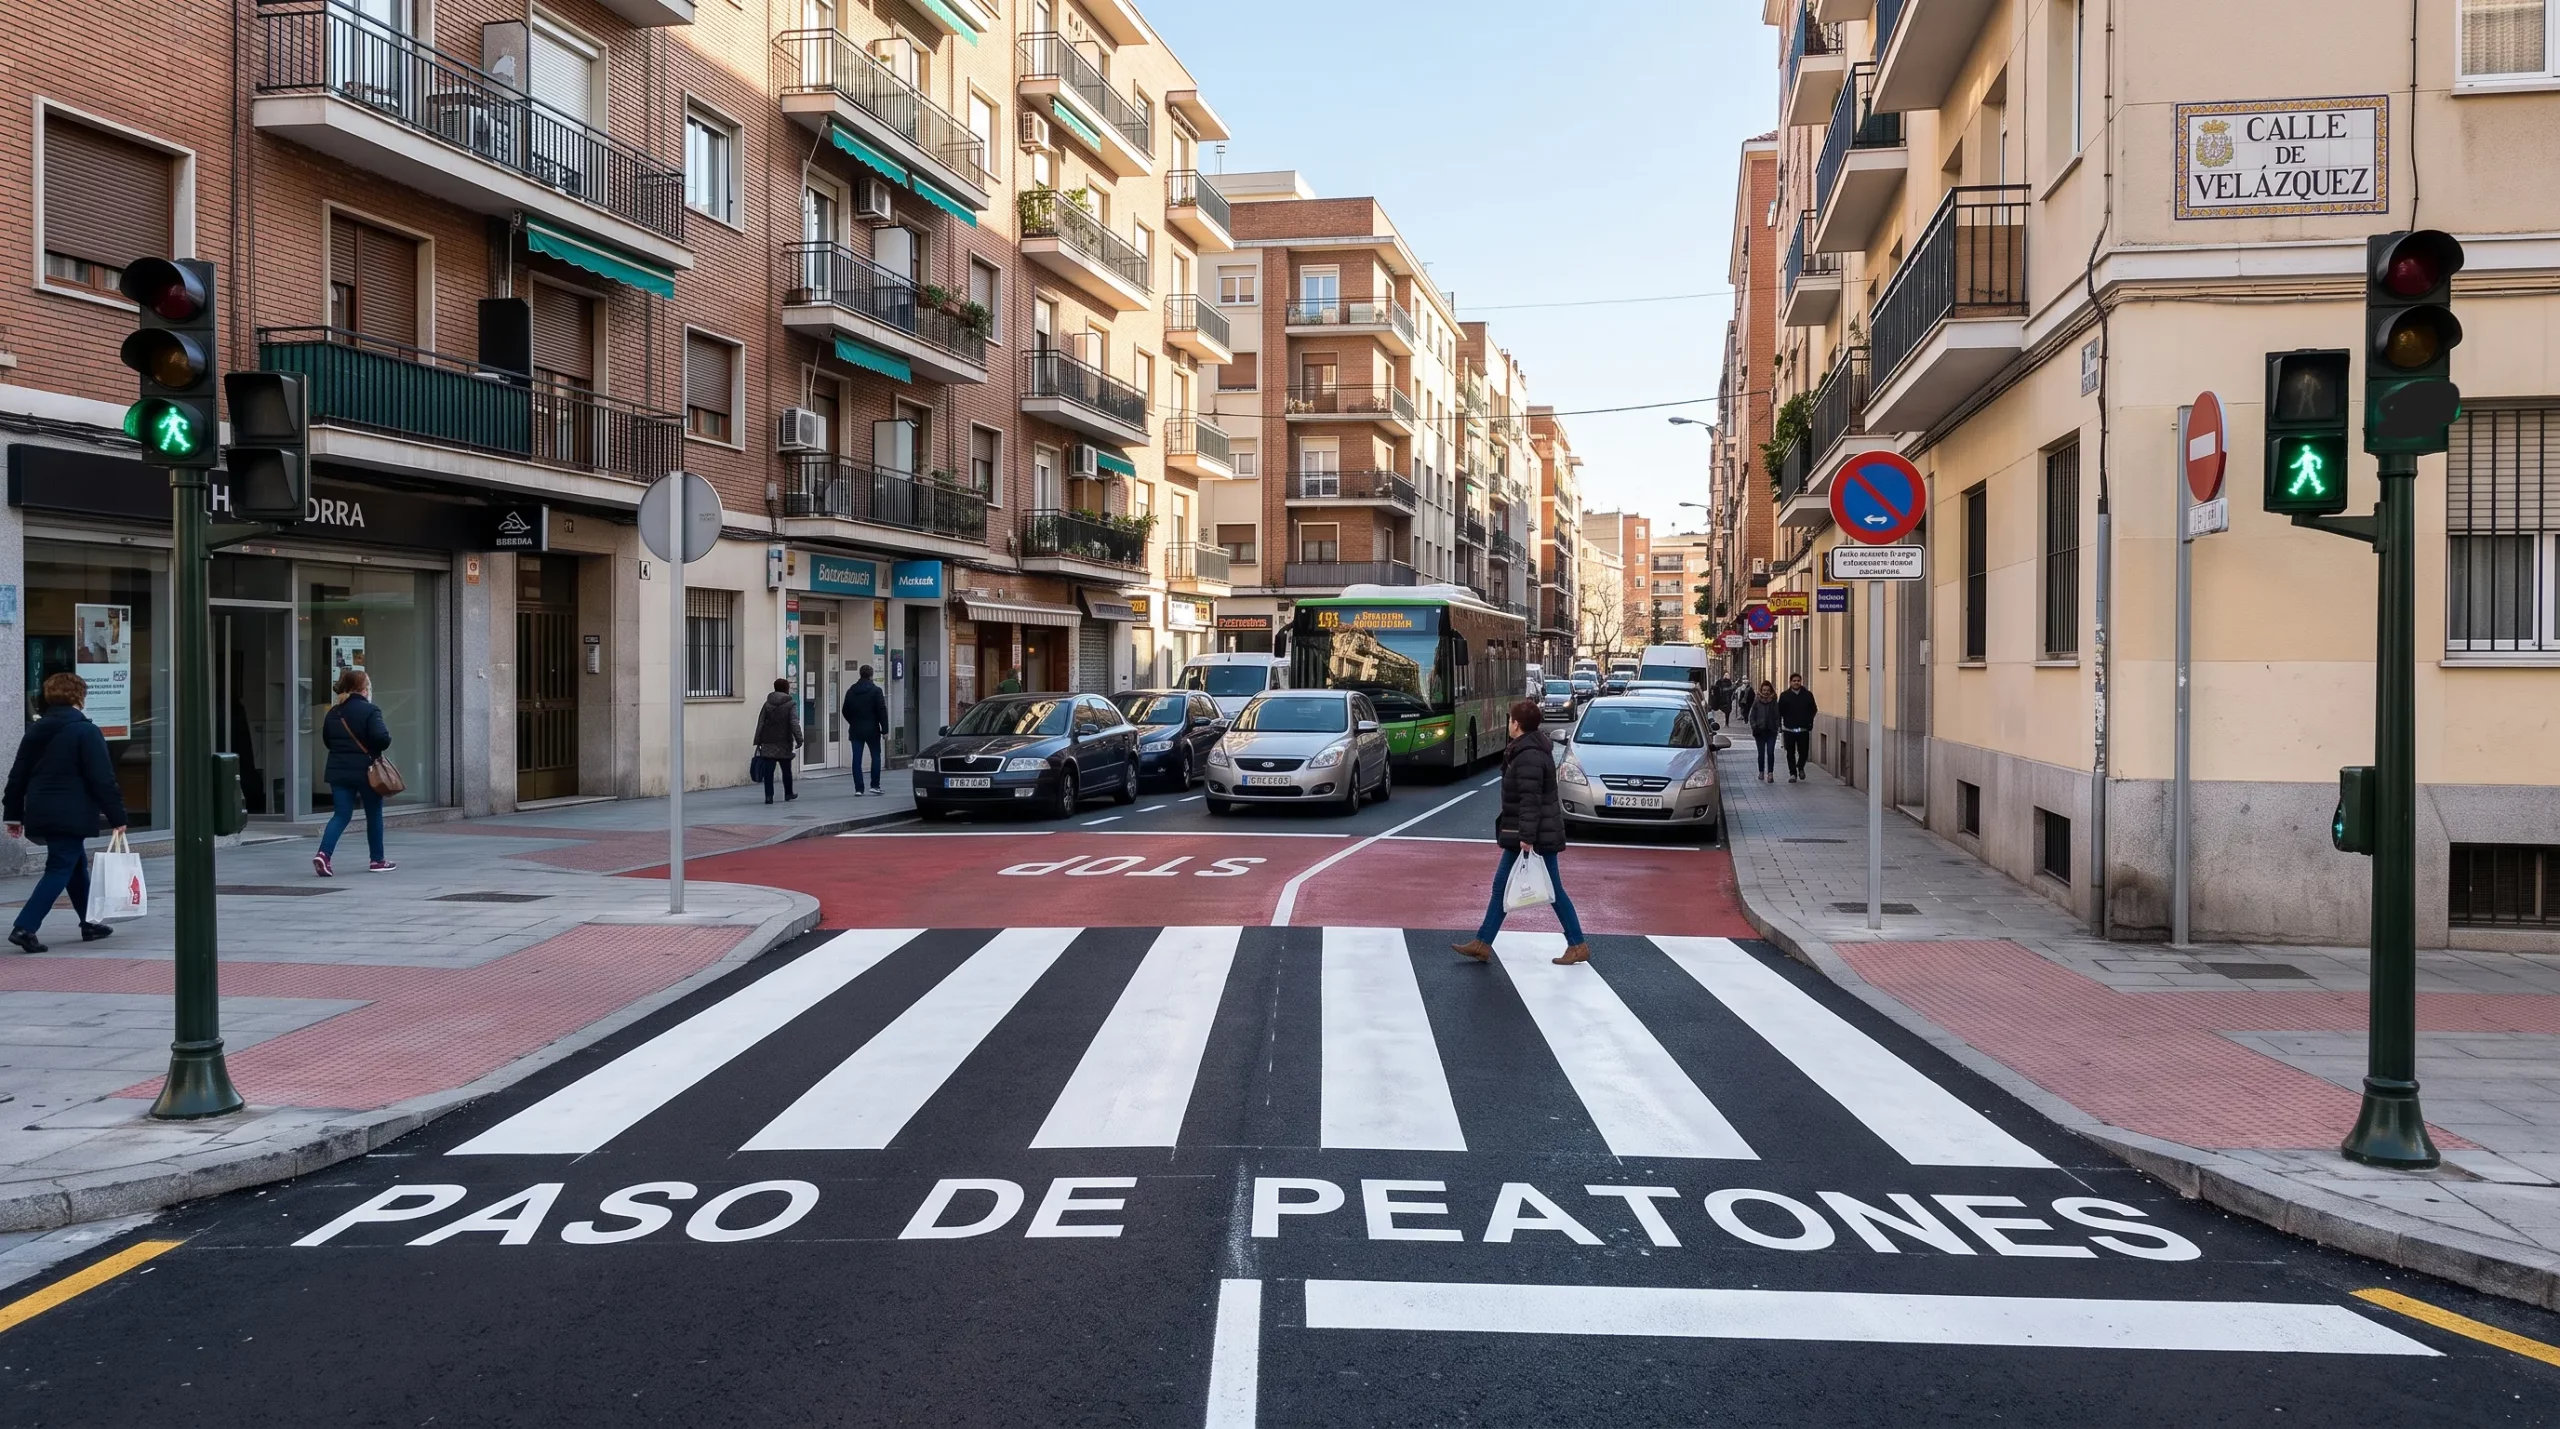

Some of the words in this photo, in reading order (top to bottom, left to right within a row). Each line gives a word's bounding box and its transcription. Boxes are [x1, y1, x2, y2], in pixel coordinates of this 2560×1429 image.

[2246, 113, 2347, 142] CALLE
[2275, 145, 2306, 165] DE
[2194, 164, 2370, 201] VELÁZQUEZ
[997, 855, 1268, 877] STOP
[290, 1179, 820, 1247] PASO
[897, 1176, 1138, 1240] DE
[1251, 1177, 2203, 1262] PEATONES
